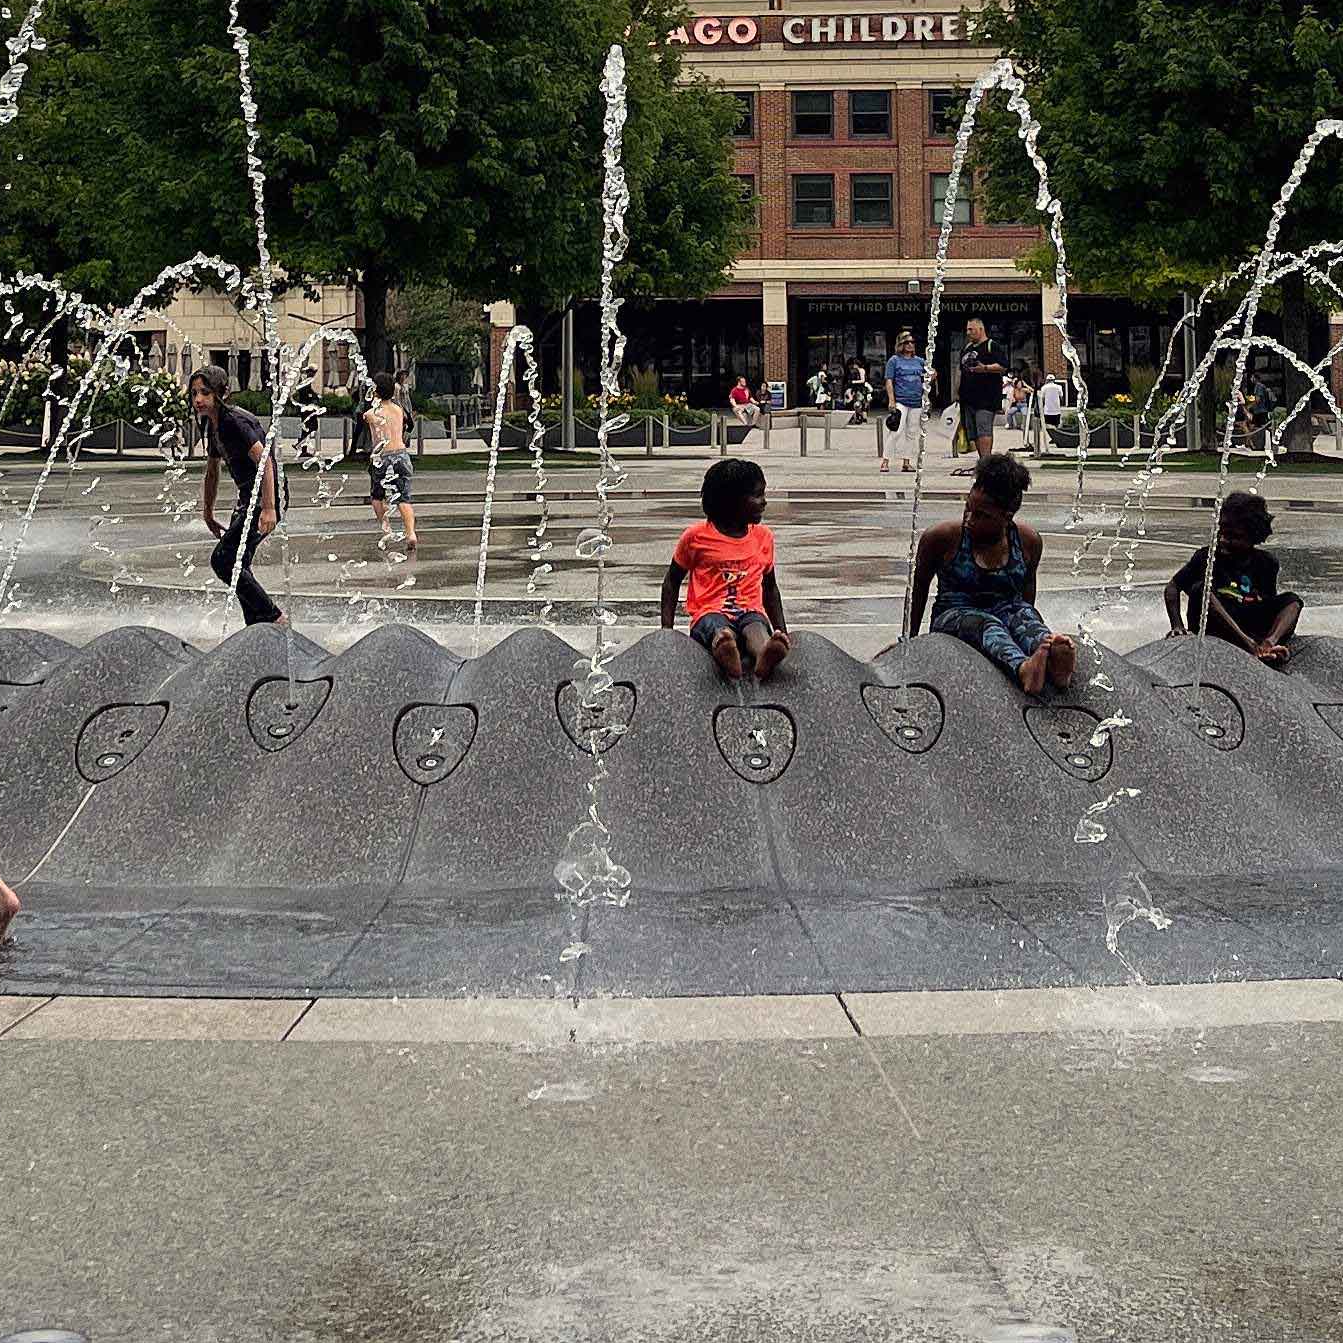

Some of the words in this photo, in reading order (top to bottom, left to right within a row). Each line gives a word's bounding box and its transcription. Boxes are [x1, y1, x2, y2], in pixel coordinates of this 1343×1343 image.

[808, 302, 843, 313] FIFTH
[847, 302, 883, 313] THIRD
[887, 302, 921, 313] BANK
[924, 302, 969, 313] FMILY
[971, 302, 1029, 313] PAVILION
